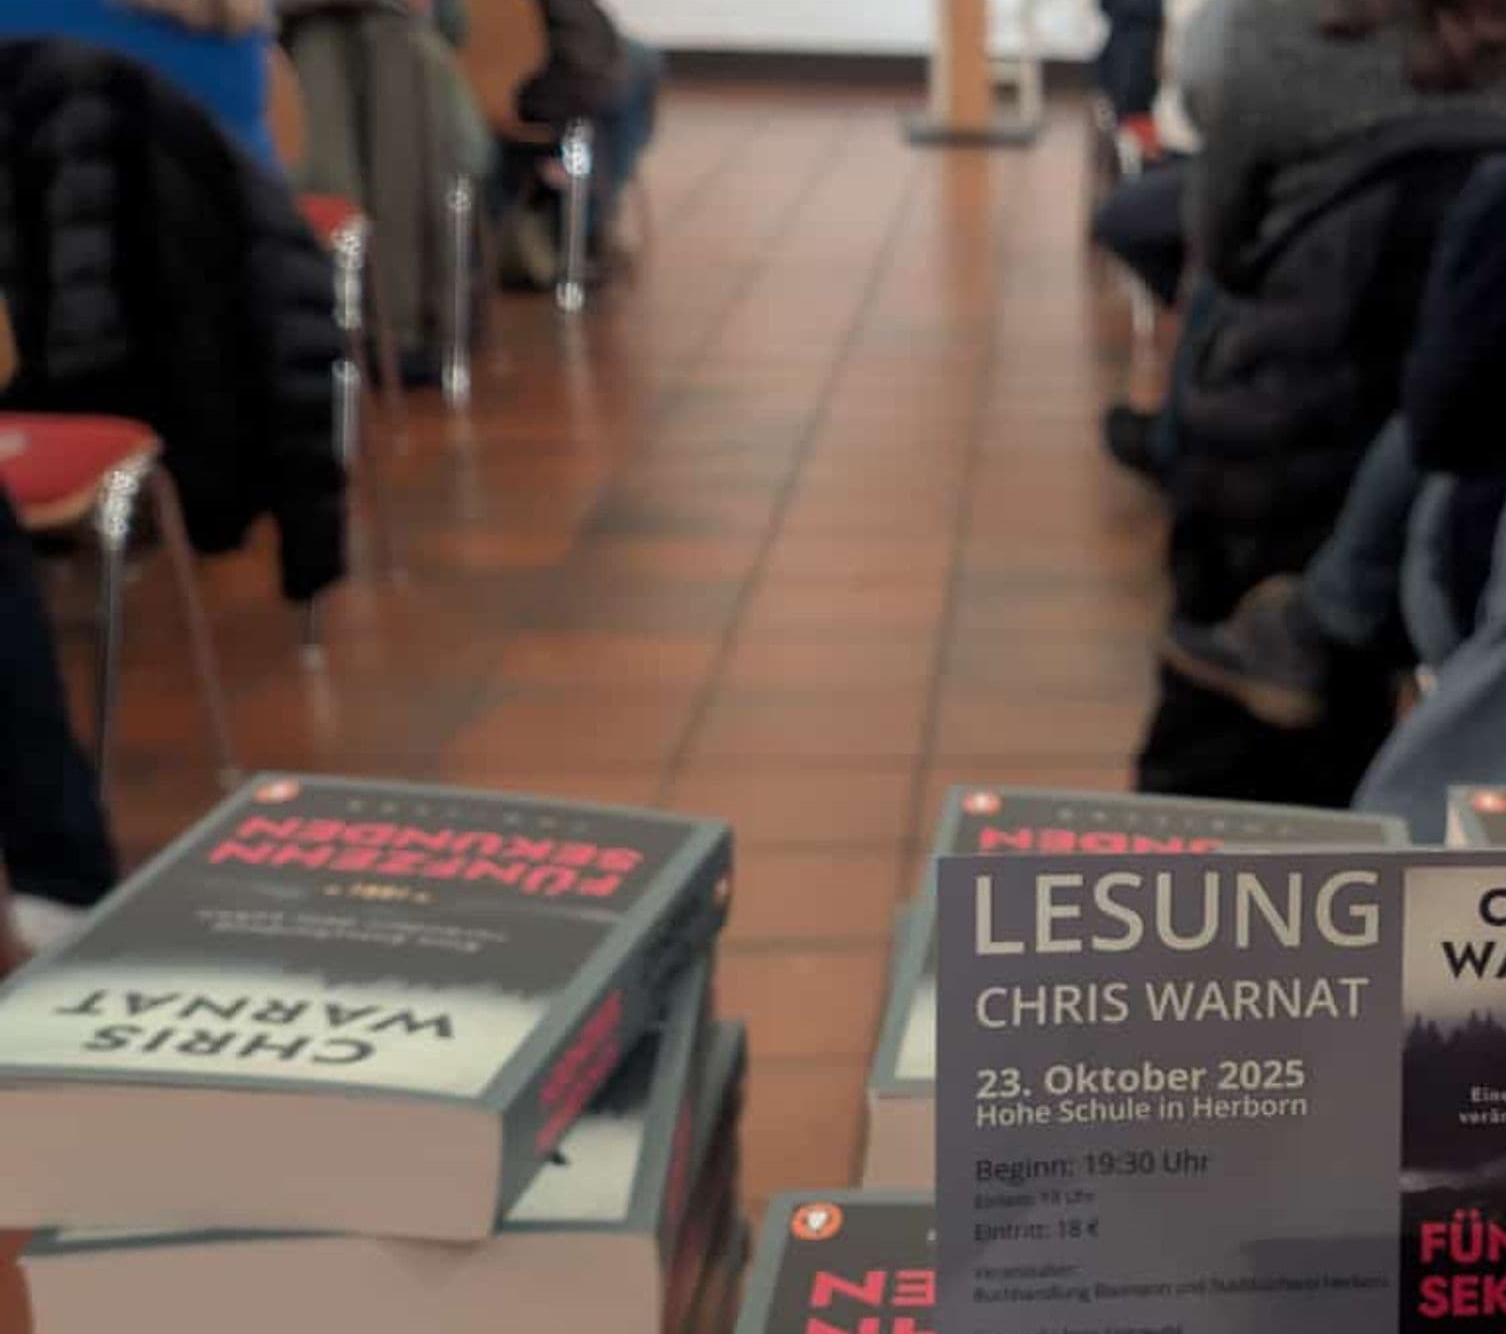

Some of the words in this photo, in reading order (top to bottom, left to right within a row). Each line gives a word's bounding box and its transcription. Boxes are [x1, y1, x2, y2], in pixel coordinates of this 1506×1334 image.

[209, 842, 620, 896] FÜNFZEHN
[235, 817, 642, 872] SEKUNDEN
[975, 870, 1380, 955] LESUNG
[56, 988, 456, 1040] WARNAT
[976, 983, 1130, 1028] CHRIS
[1144, 977, 1369, 1023] WARNAT
[81, 1023, 379, 1066] CHRIS
[976, 1068, 1032, 1100] 23.
[1044, 1061, 1207, 1096] Oktober
[1218, 1059, 1306, 1091] 2025
[976, 1101, 1051, 1128] Hohe
[1058, 1097, 1152, 1124] Schule
[1159, 1095, 1184, 1120] in
[1192, 1095, 1307, 1120] Herborn
[975, 1157, 1075, 1186] Beginn:
[1083, 1150, 1156, 1177] 19:30
[1163, 1148, 1210, 1176] Uhr
